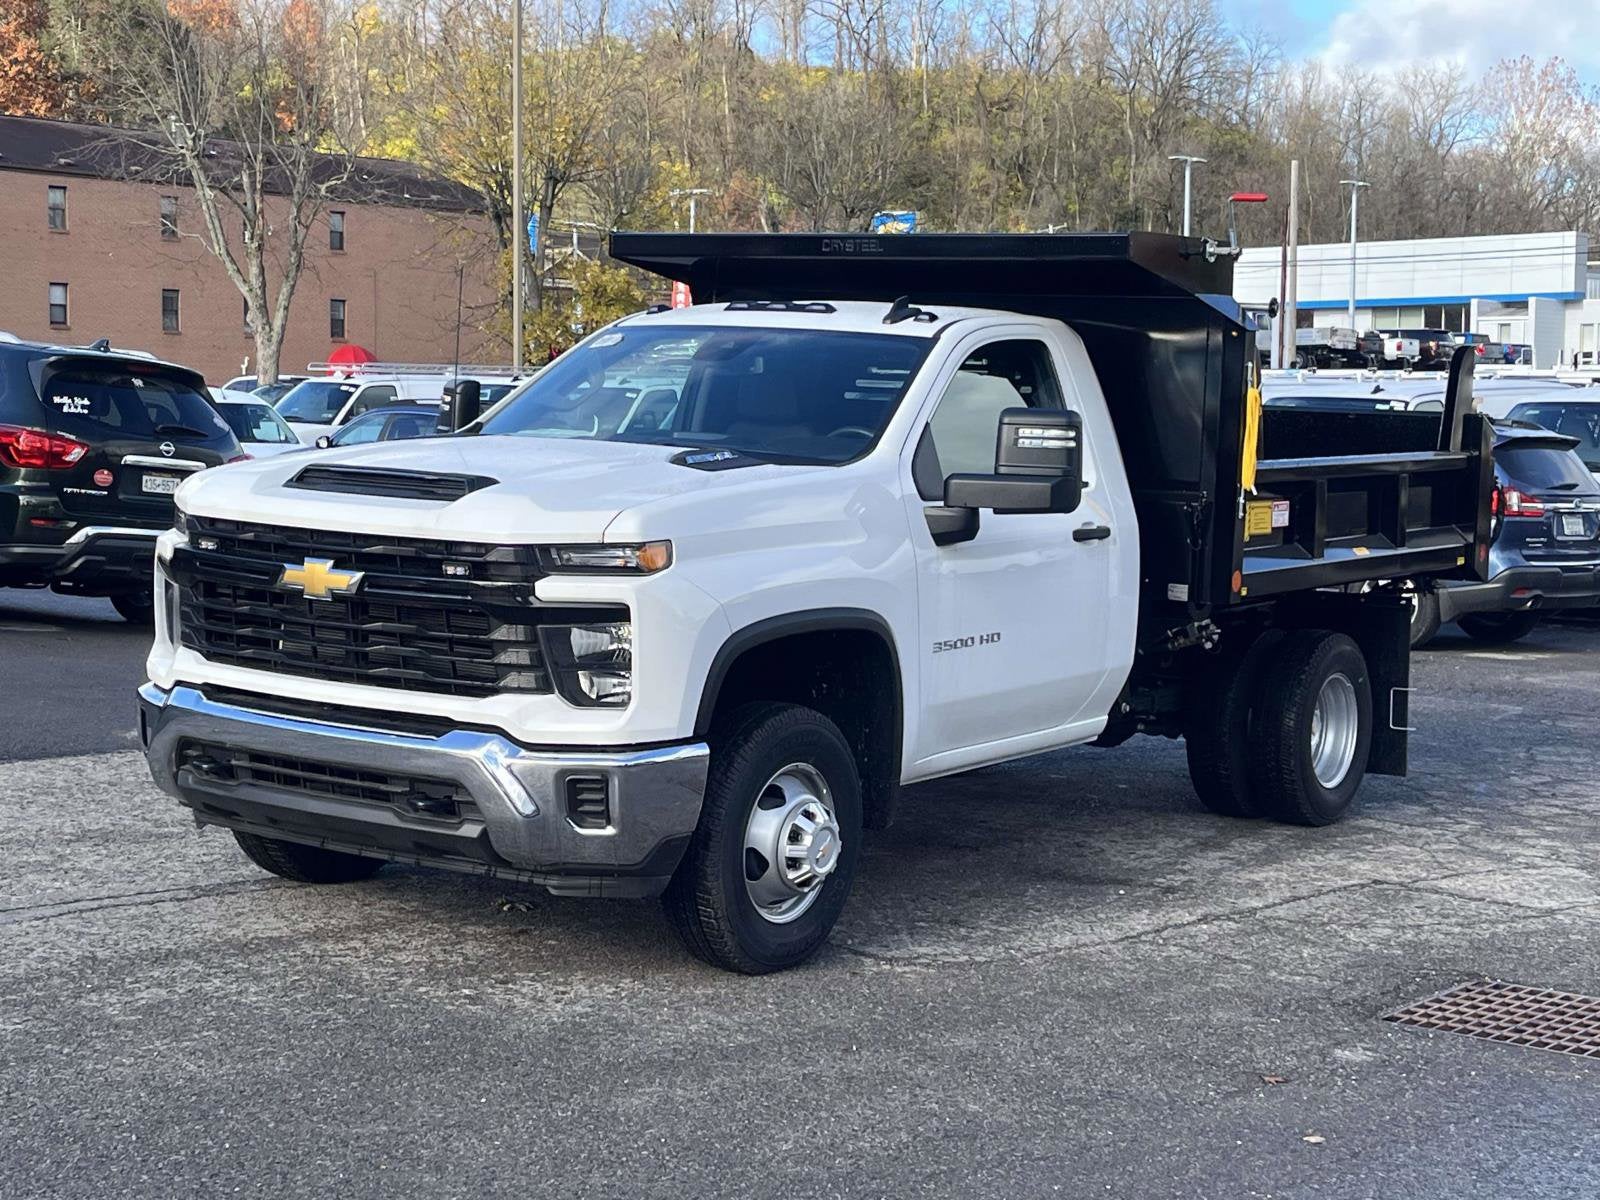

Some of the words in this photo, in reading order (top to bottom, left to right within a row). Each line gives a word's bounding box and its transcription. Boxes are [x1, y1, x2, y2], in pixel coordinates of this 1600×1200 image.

[822, 239, 884, 251] CRYSTEEL
[932, 636, 975, 653] 3500
[979, 632, 1001, 645] HD
